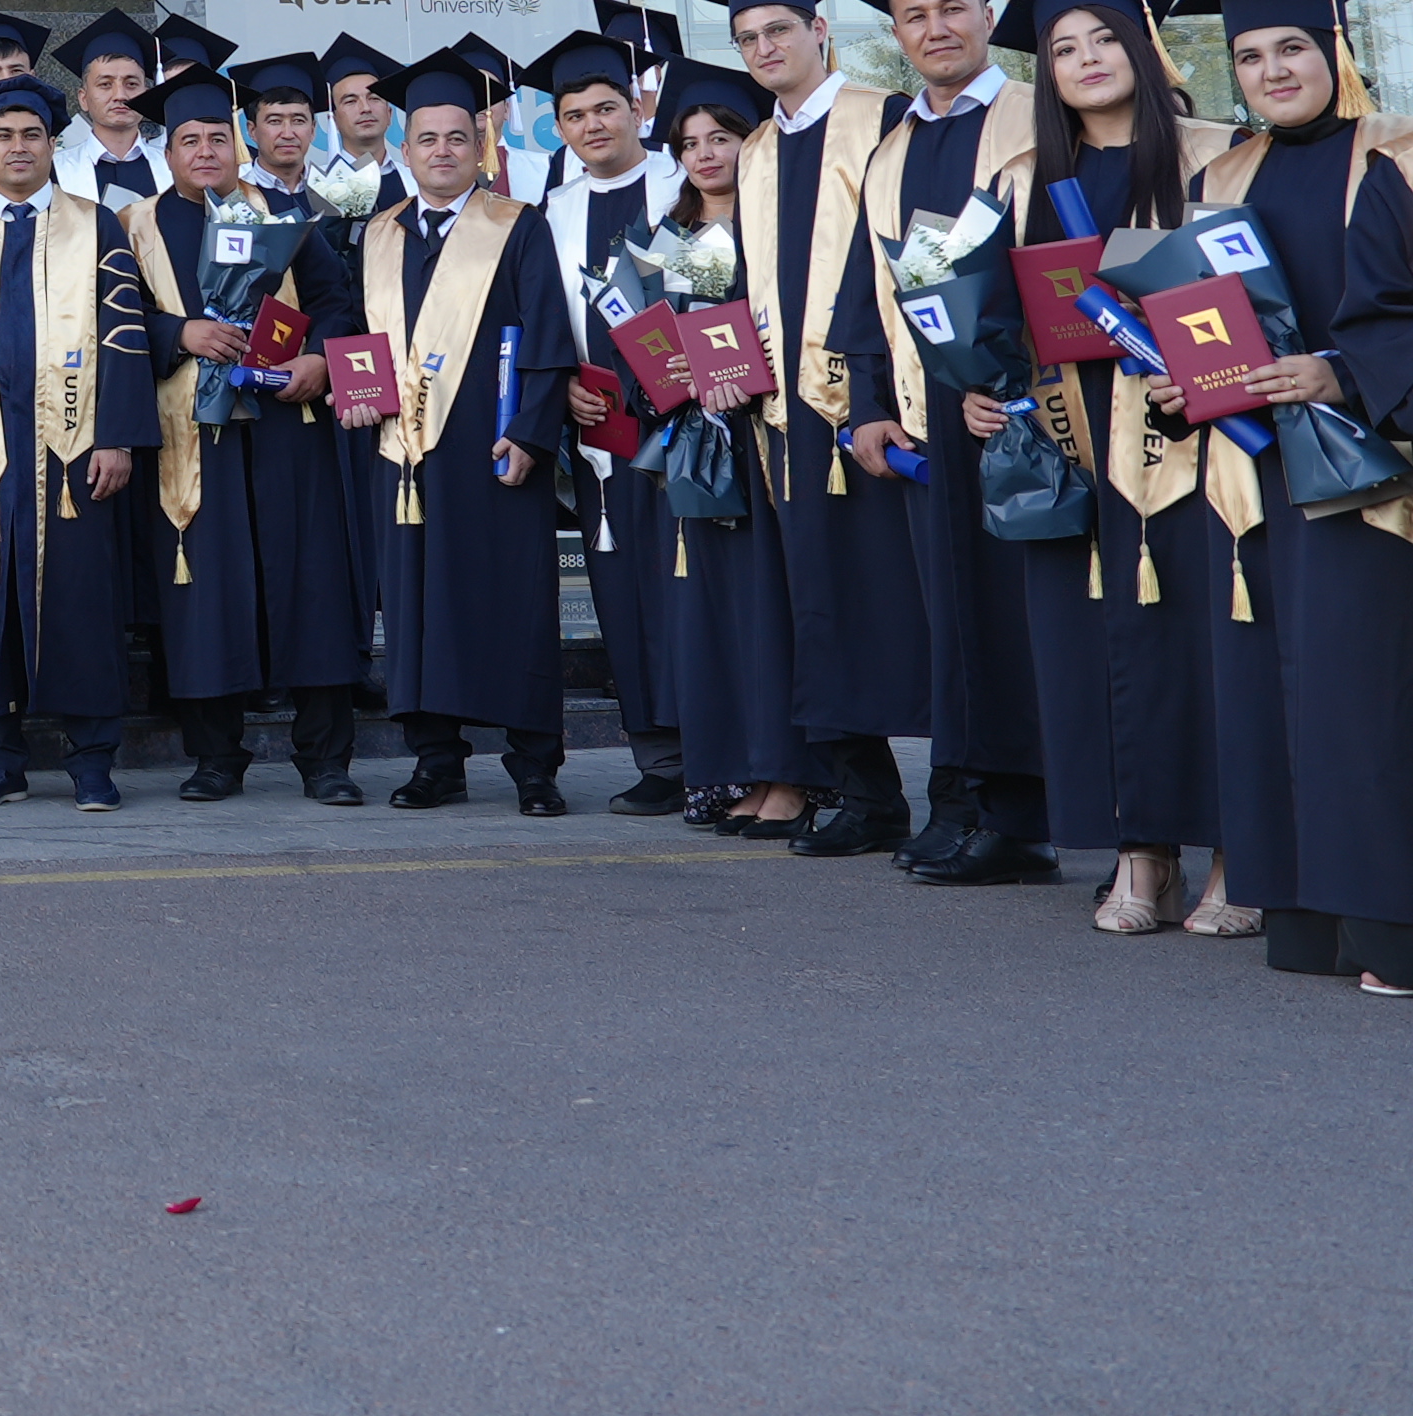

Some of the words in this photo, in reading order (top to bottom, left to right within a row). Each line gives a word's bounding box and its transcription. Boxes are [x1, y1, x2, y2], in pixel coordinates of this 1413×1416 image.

[1049, 320, 1097, 334] MAGIST
[708, 363, 751, 379] MAGISTR
[827, 355, 845, 386] EA
[1192, 363, 1251, 385] MAGISTR
[1201, 375, 1243, 392] DIPLOM
[64, 374, 78, 432] UDEA
[413, 375, 433, 432] UDEA
